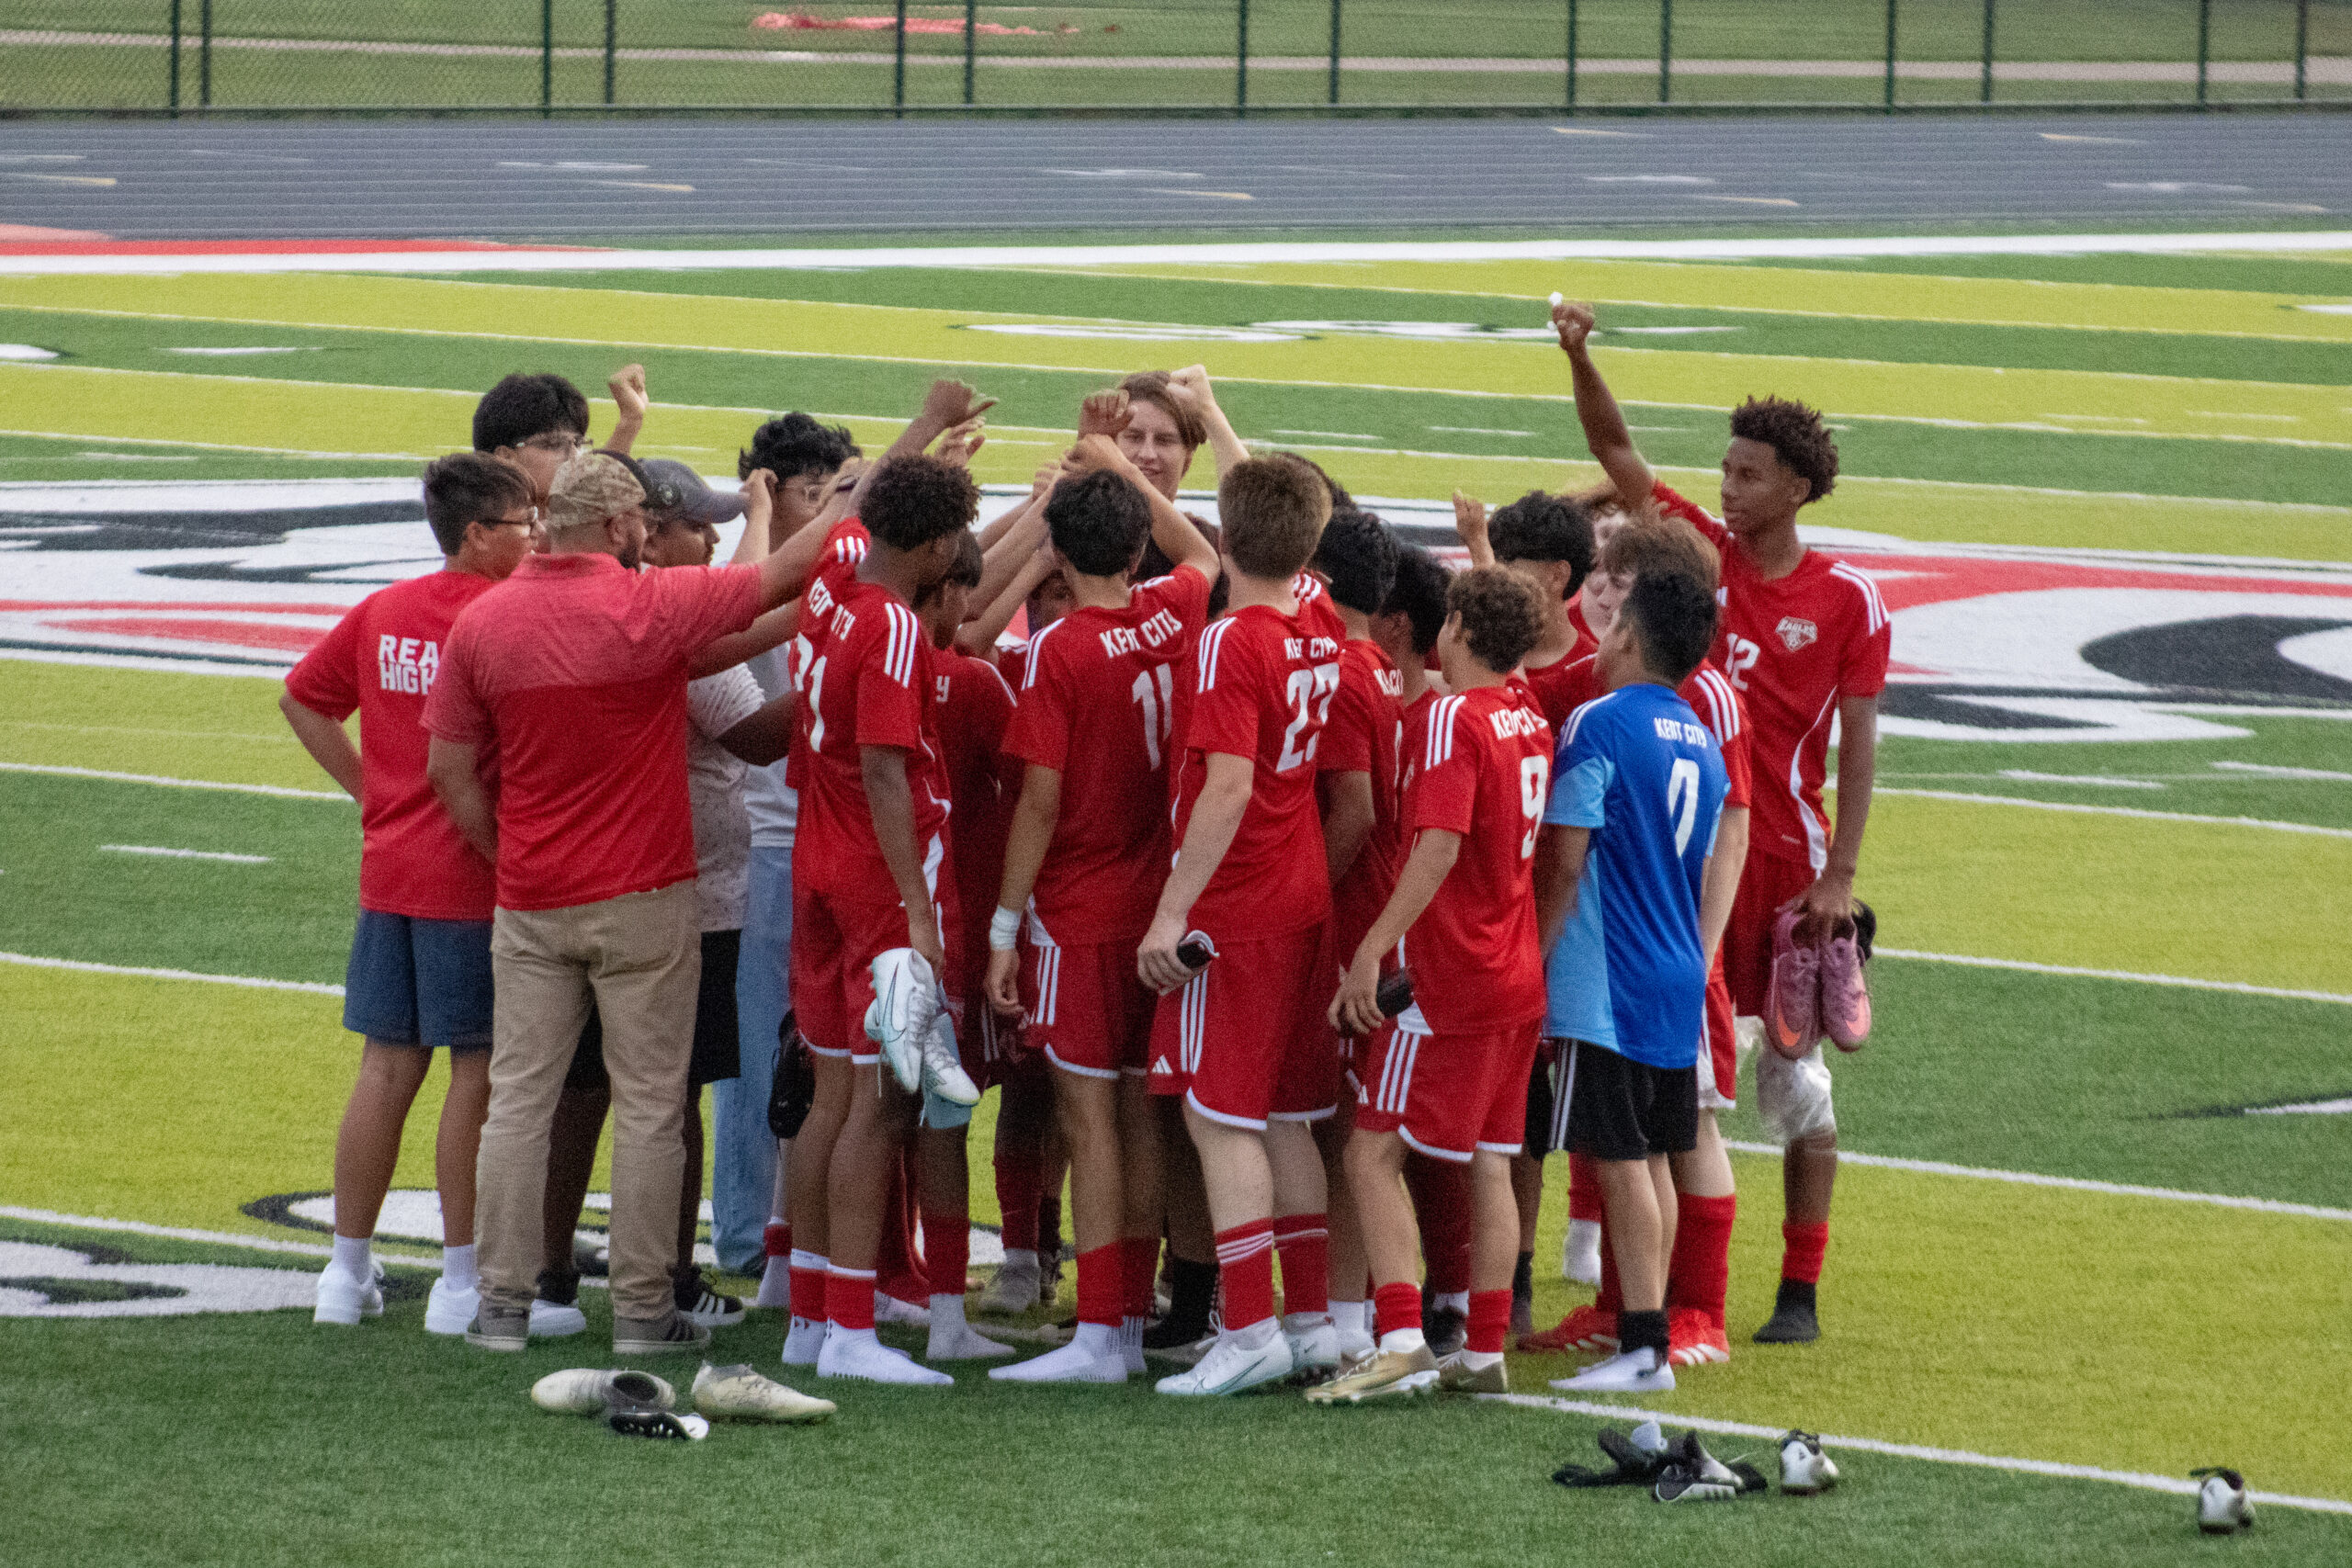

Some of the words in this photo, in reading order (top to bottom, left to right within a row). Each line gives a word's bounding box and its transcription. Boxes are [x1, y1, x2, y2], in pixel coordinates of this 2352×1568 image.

[379, 634, 439, 669] REA
[1724, 632, 1761, 692] 12
[1131, 661, 1174, 772] 11
[1275, 661, 1340, 773] 27
[1654, 716, 1683, 742] KENT
[1683, 722, 1708, 750] CITY
[1521, 754, 1549, 860] 9
